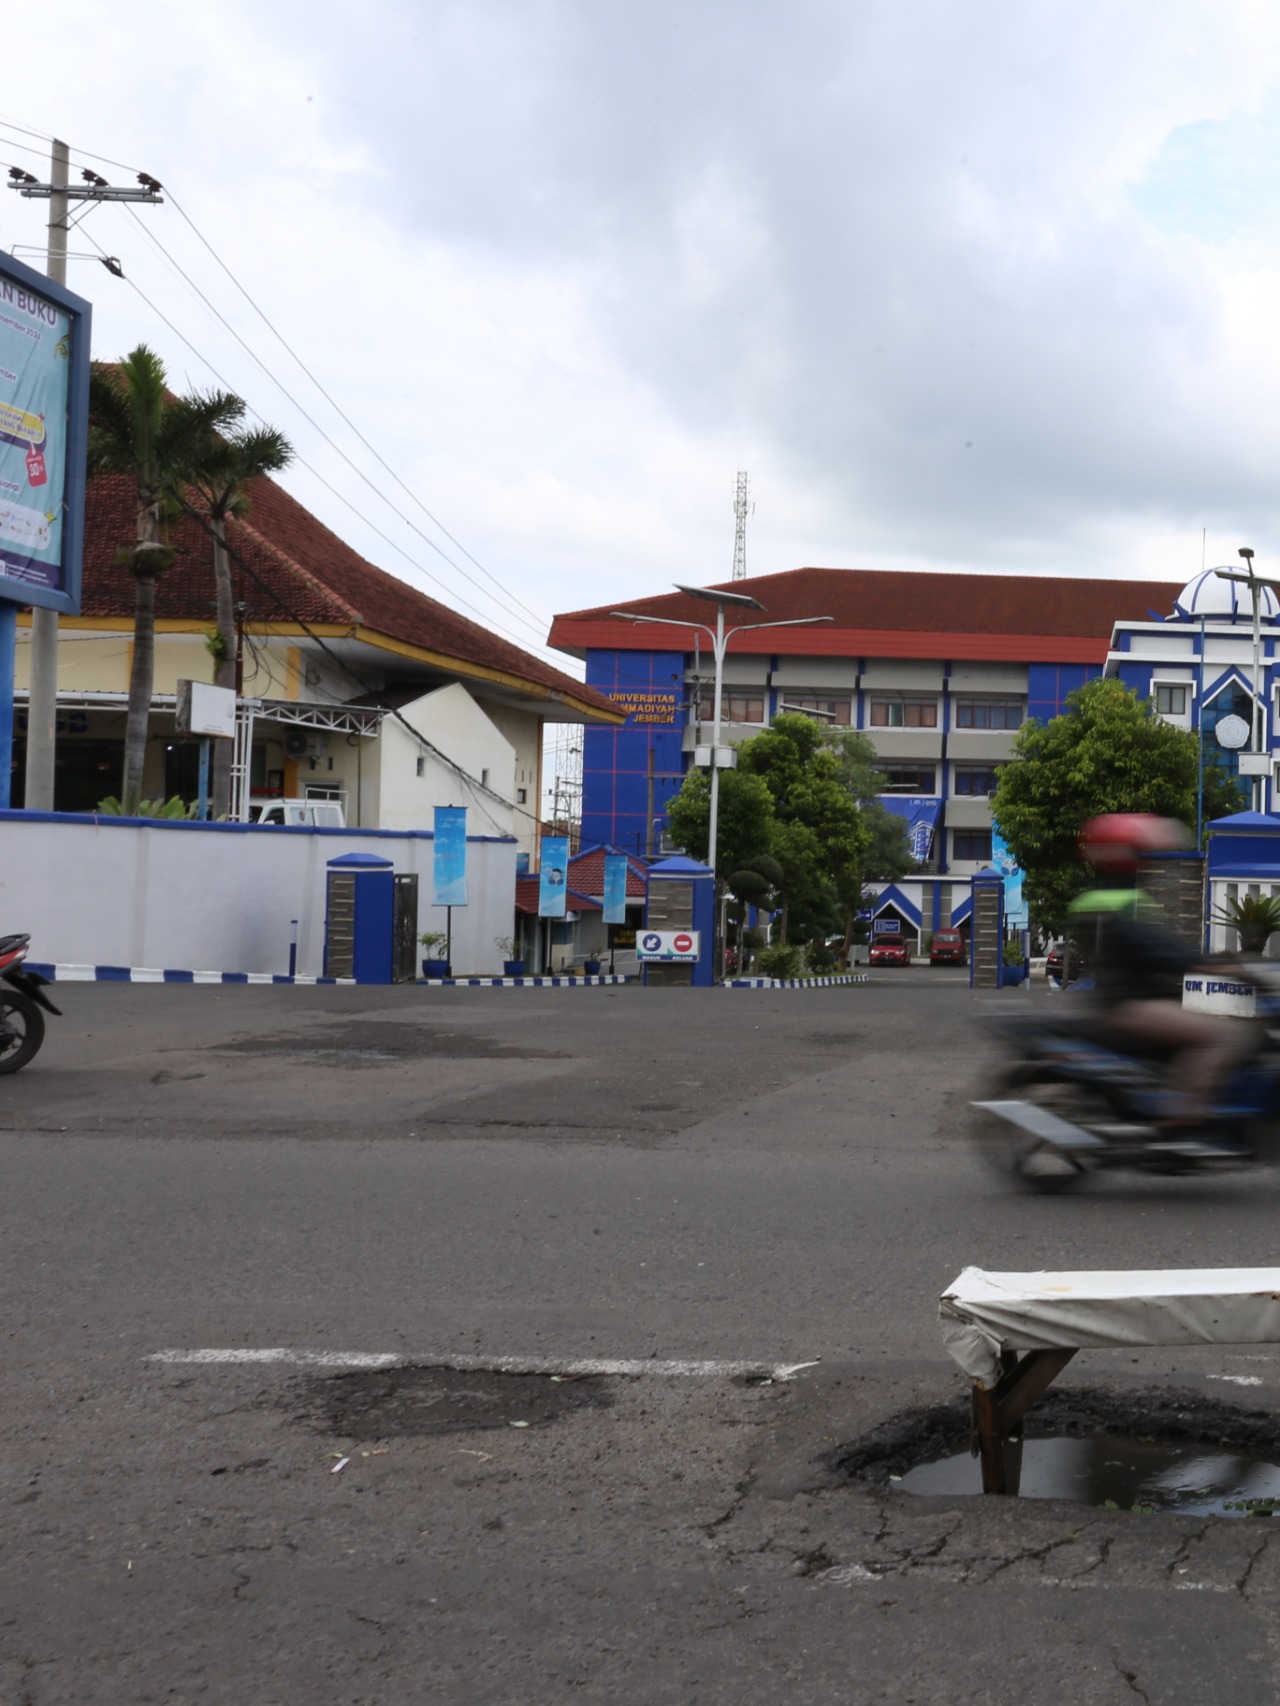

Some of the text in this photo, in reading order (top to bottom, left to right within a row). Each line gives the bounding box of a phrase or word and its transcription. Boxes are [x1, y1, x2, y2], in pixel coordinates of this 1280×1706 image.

[18, 291, 56, 326] BUKU
[609, 692, 675, 703] UNIVERSITAS
[620, 703, 675, 714] MMADIYAH
[633, 714, 674, 723] JEMBER
[1206, 981, 1254, 996] JEMBER
